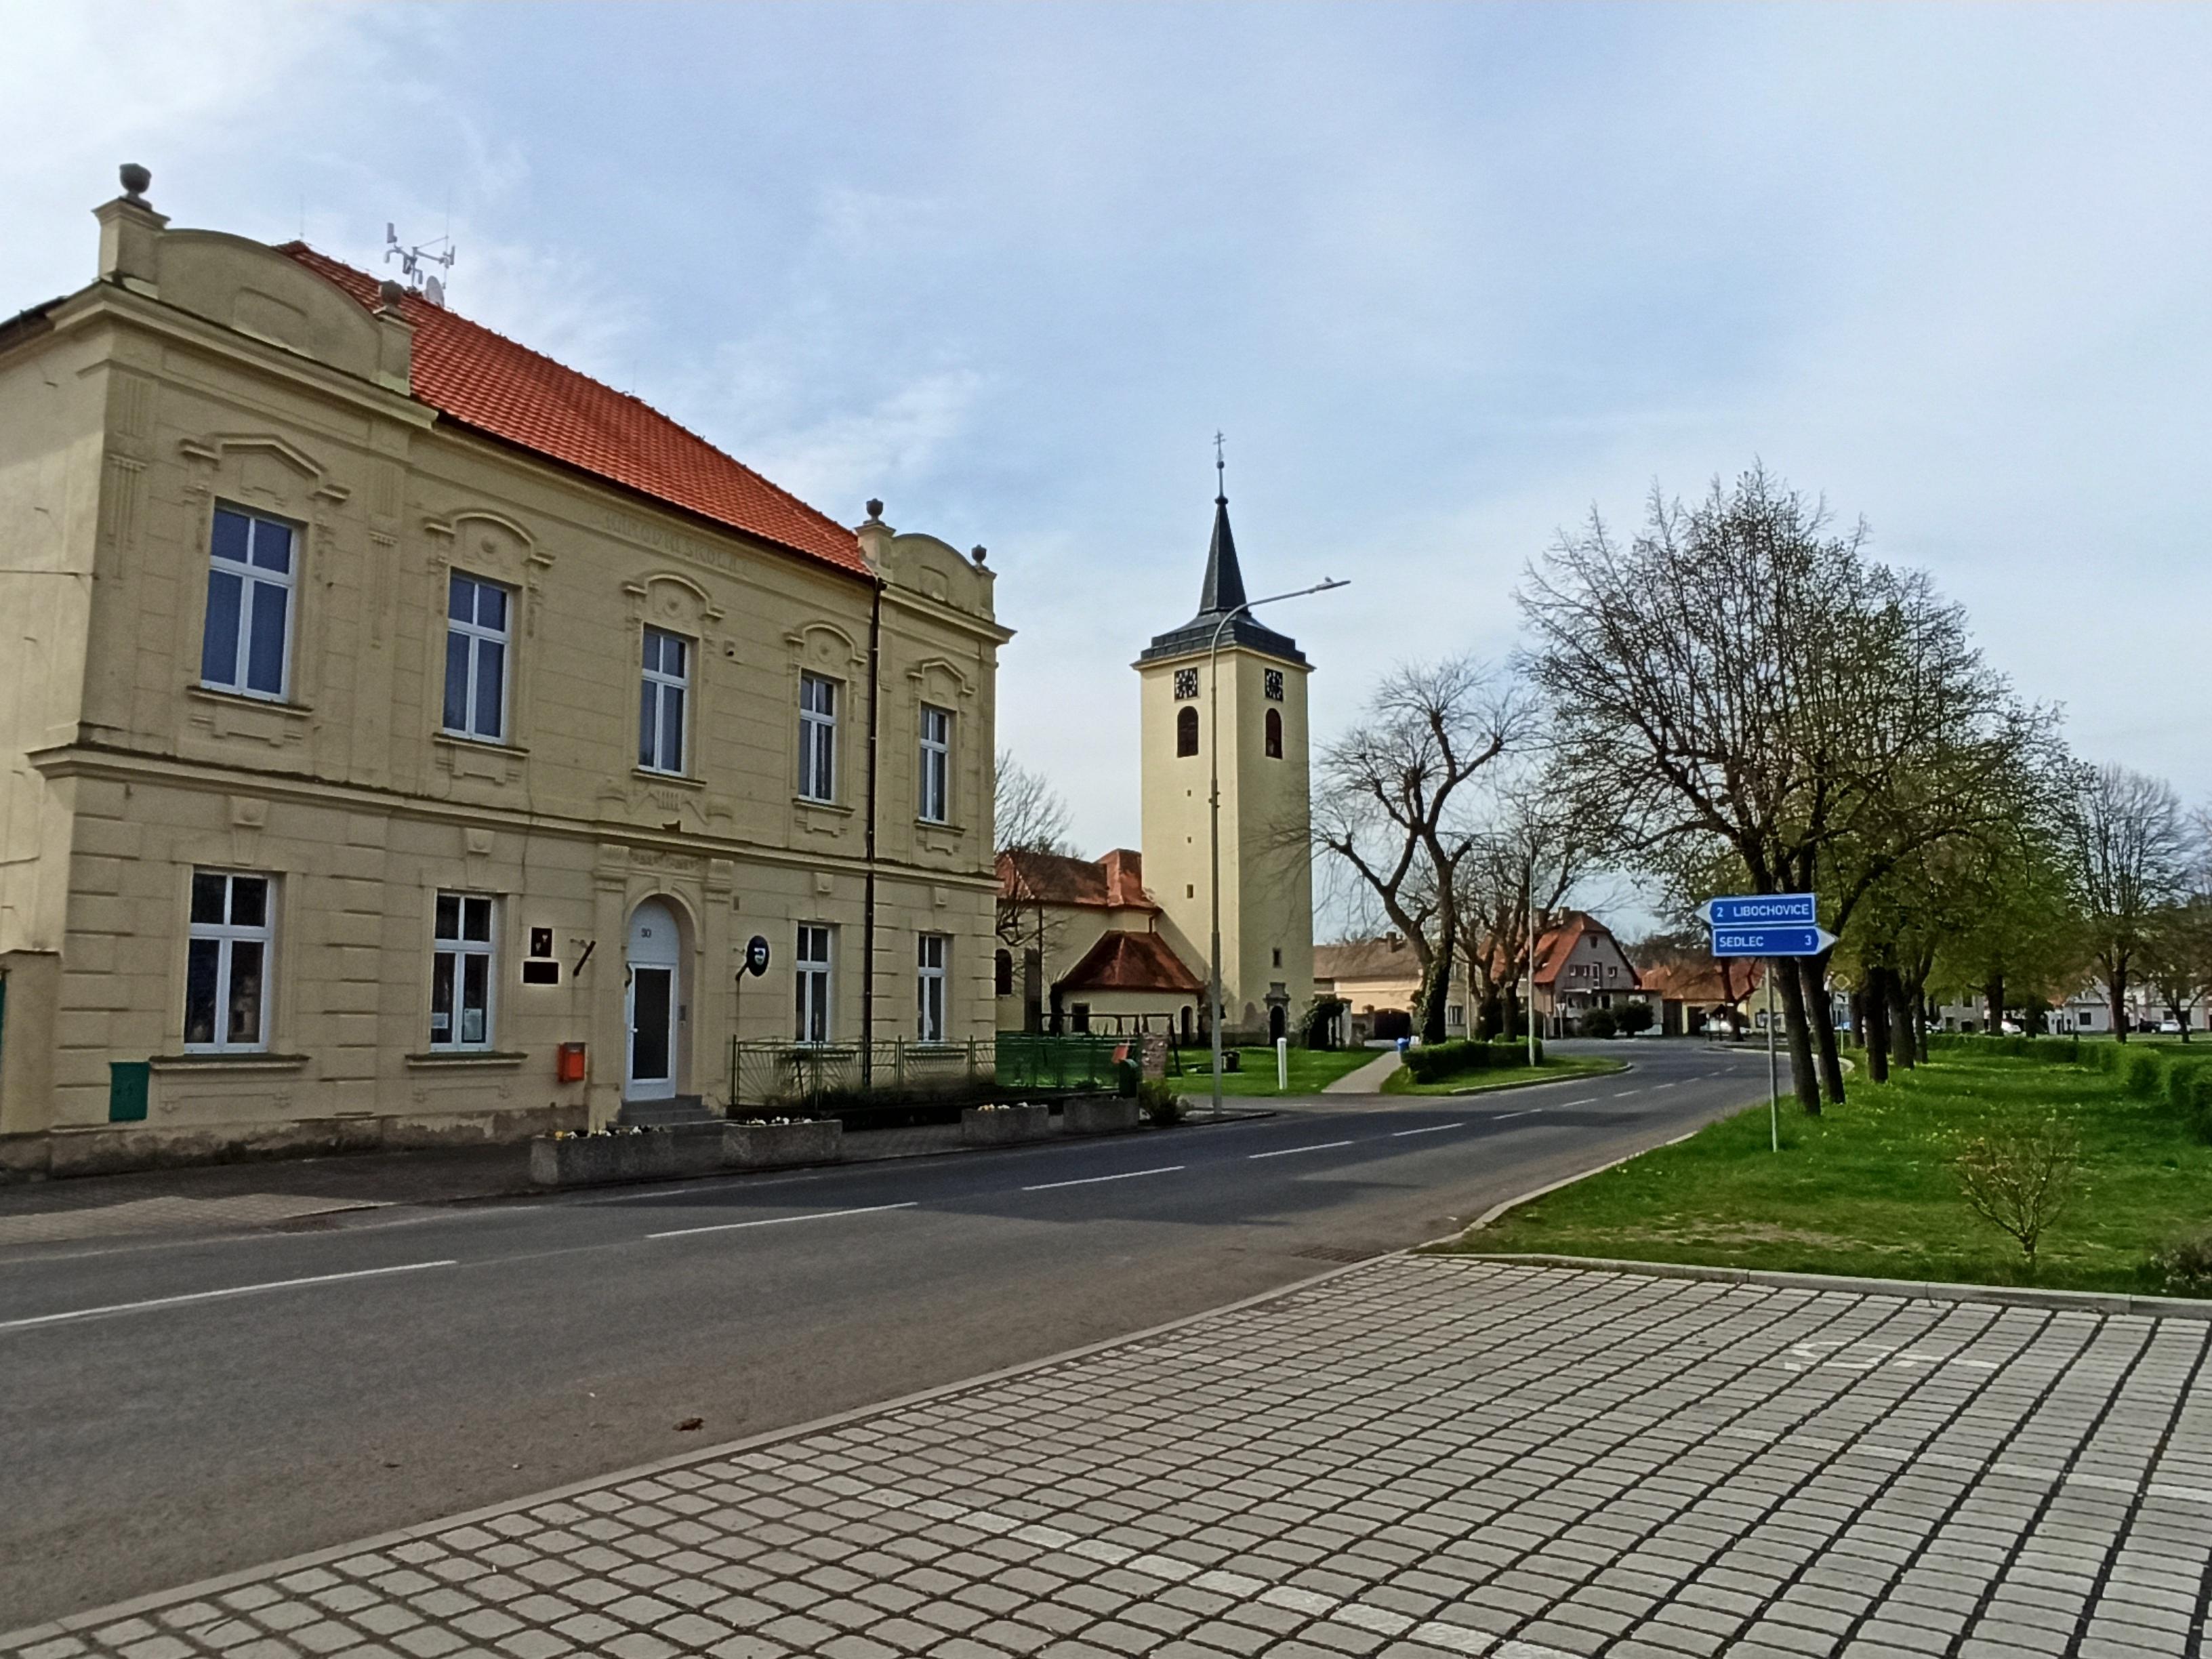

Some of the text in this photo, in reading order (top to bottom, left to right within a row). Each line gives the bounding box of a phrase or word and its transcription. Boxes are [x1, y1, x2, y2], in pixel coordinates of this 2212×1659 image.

[1717, 903, 1809, 918] 2 LIBOCHOVICE
[1719, 935, 1811, 947] SEDLEC 3
